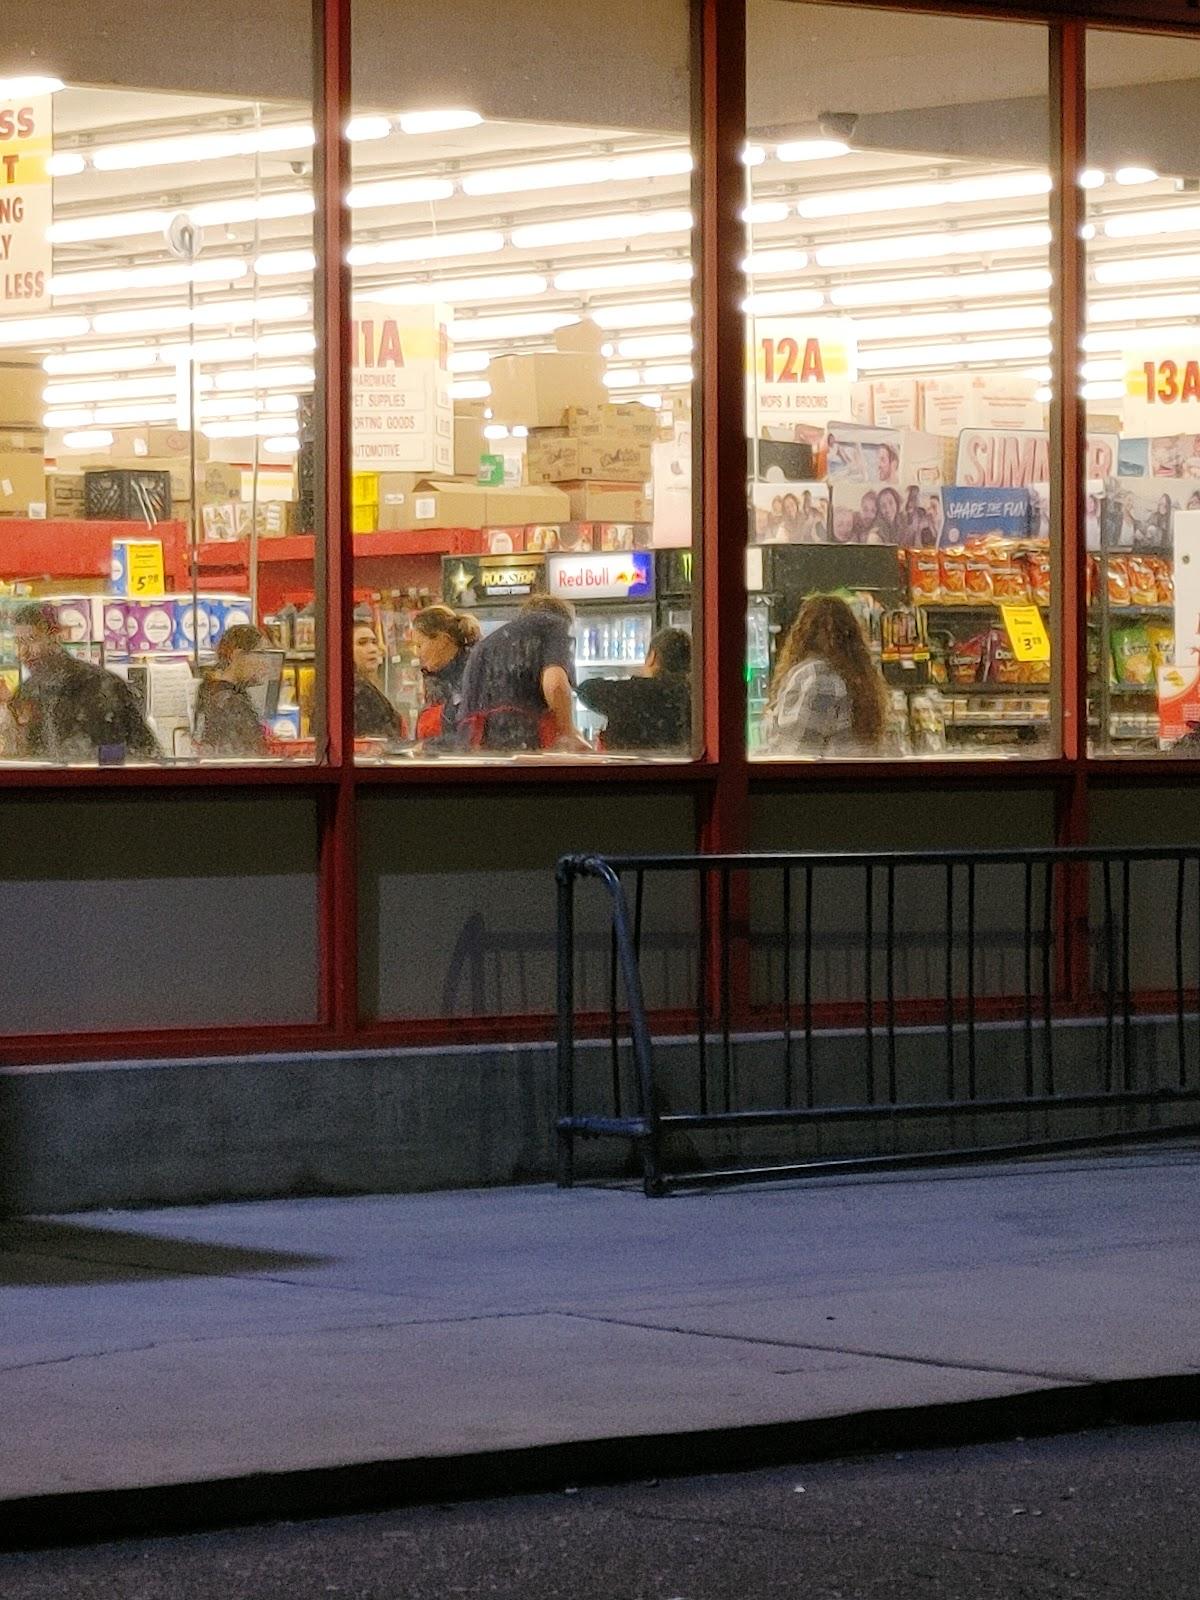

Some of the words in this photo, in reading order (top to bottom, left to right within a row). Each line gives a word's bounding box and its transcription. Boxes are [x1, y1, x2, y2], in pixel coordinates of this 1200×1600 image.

[0, 234, 12, 260] Y
[5, 270, 45, 300] LESS
[761, 337, 825, 383] 12A
[1143, 360, 1200, 404] 13A
[353, 394, 364, 407] ET
[368, 394, 406, 407] SUPPLIES
[353, 416, 382, 430] ORTING
[387, 416, 415, 429] GOODS
[353, 444, 401, 457] UTOMOTIVE
[947, 502, 986, 519] SHARE
[1004, 502, 1027, 517] FUN
[559, 568, 583, 587] Red
[585, 567, 609, 586] Bull
